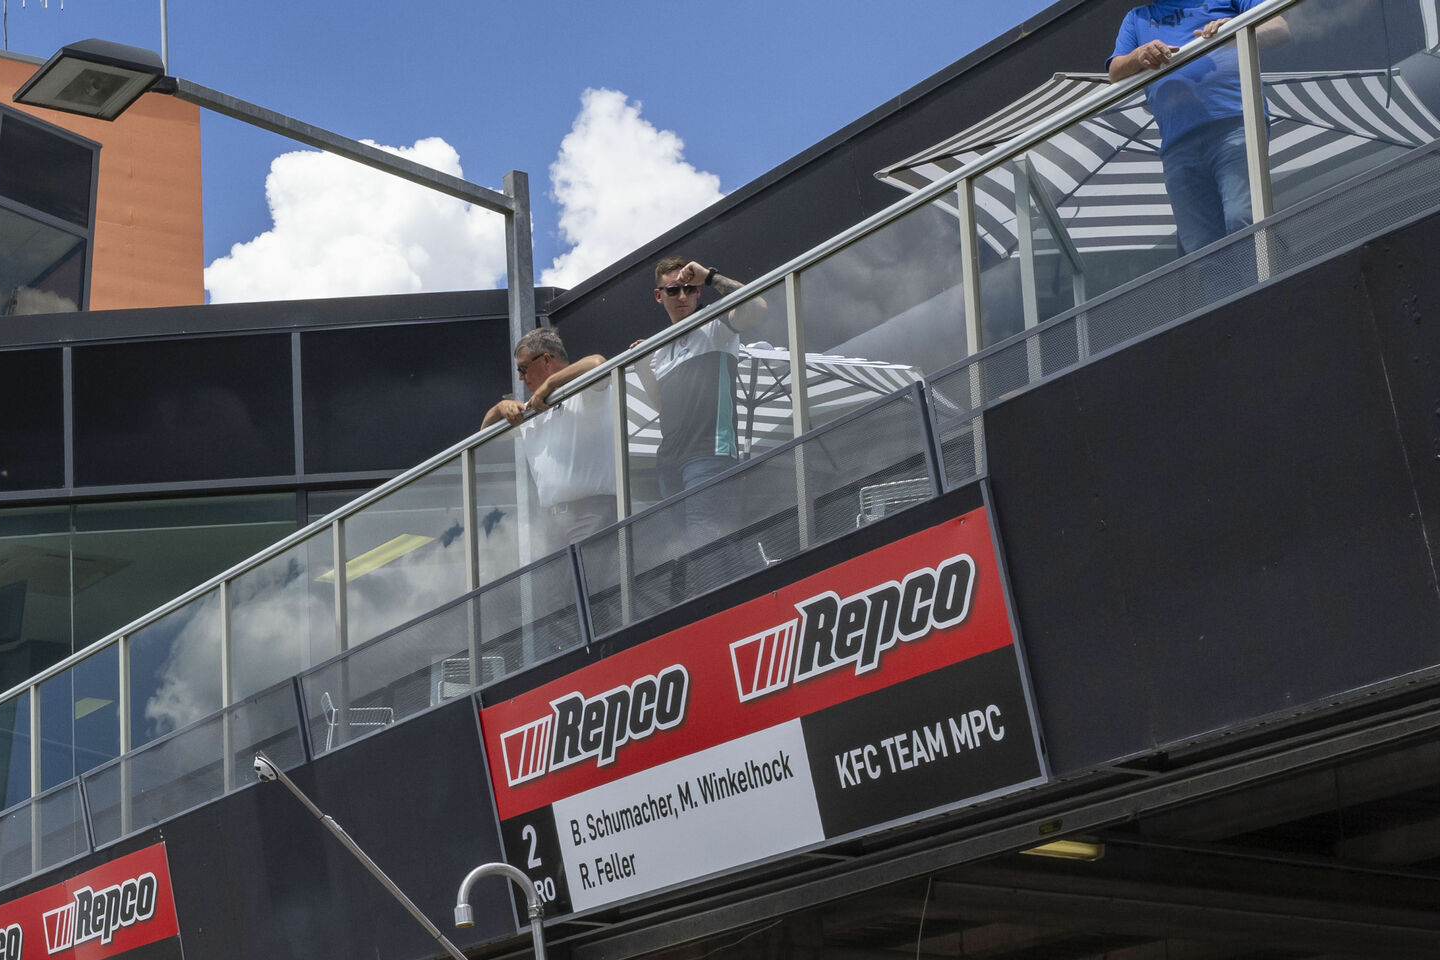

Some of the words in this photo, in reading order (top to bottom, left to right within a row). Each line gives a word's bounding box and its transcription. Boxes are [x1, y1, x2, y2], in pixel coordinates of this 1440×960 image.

[794, 554, 976, 683] Repco
[550, 664, 689, 771] Repco
[835, 746, 881, 788] KFC
[882, 724, 947, 774] TEAM
[952, 704, 1005, 754] MPC
[570, 819, 587, 846] B.
[589, 792, 678, 840] Schumacher,
[678, 784, 698, 812] M.
[701, 751, 794, 804] Winkelhock
[522, 825, 542, 869] 2
[579, 862, 597, 890] R.
[597, 851, 636, 886] Feller
[73, 872, 158, 945] Repco
[536, 880, 556, 902] RO
